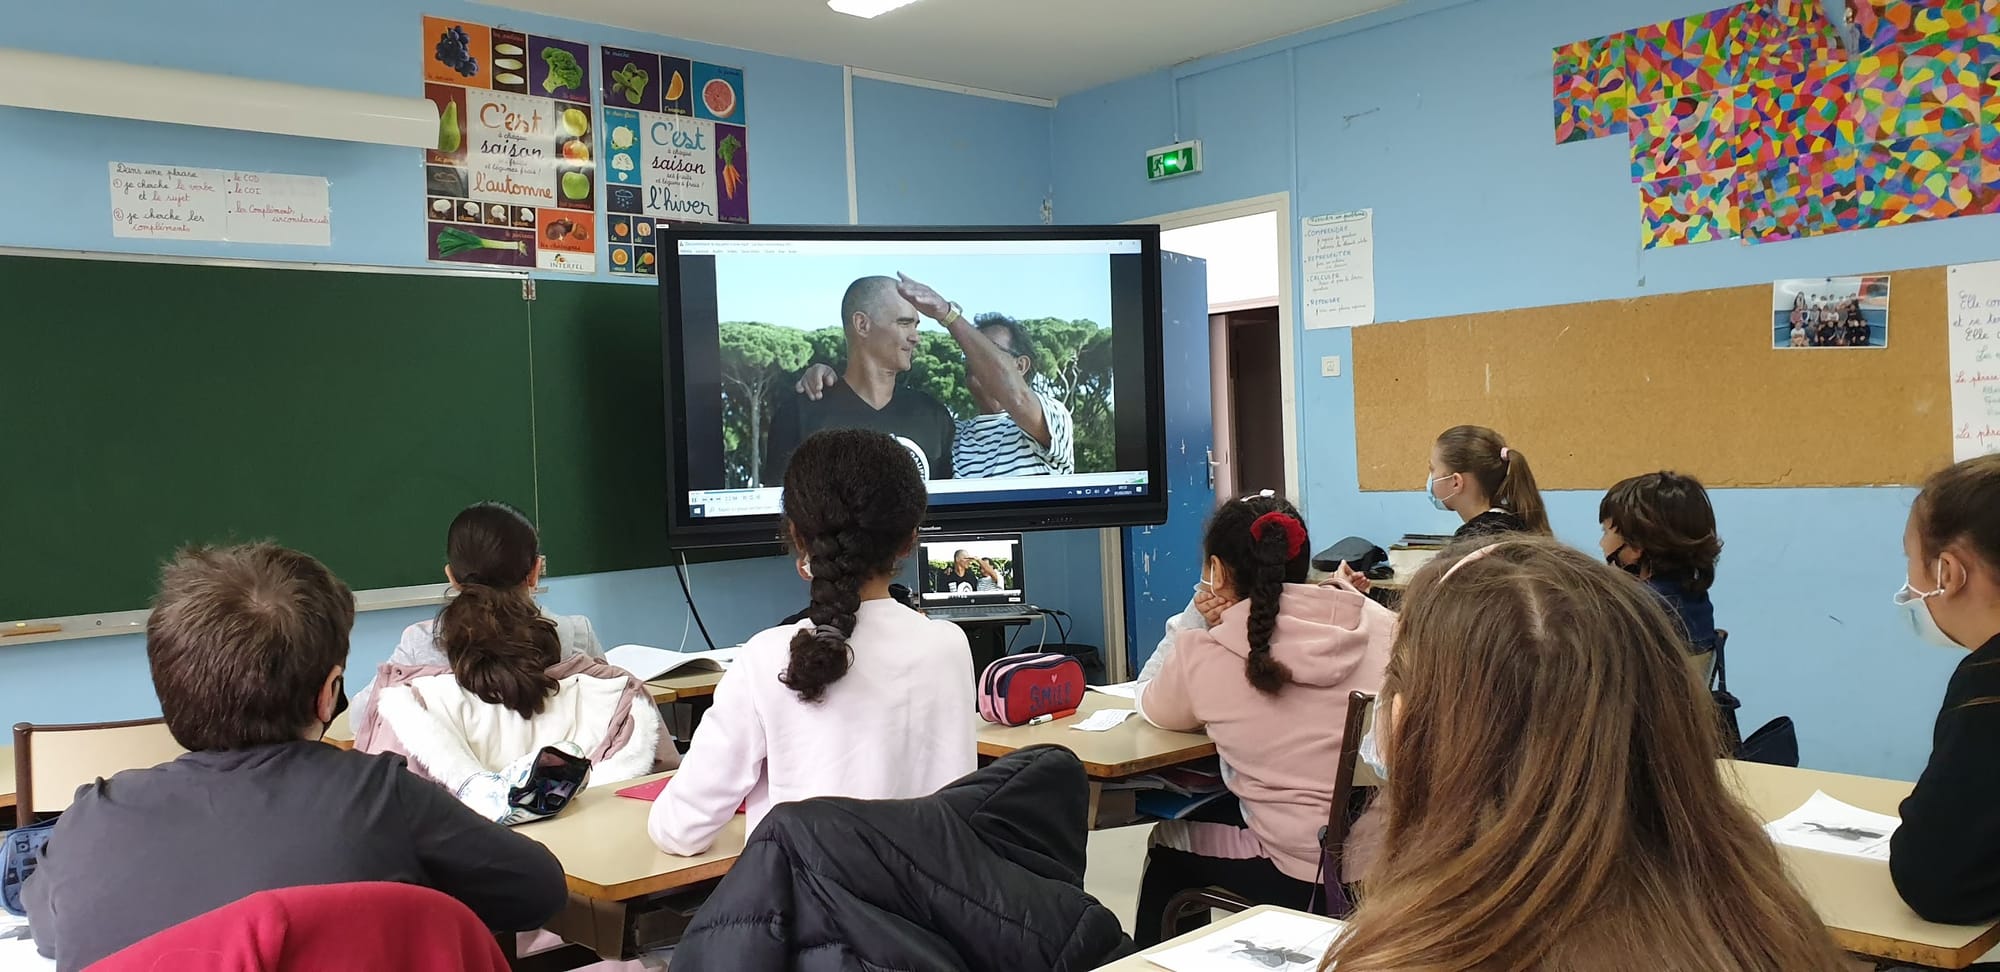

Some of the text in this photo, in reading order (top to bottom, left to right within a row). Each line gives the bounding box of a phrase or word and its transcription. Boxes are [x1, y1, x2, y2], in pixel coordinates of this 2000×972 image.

[480, 103, 542, 132] C'est
[651, 122, 706, 151] C'est
[116, 163, 142, 174] Dans
[167, 168, 198, 180] phrase
[651, 155, 706, 175] saison
[137, 179, 169, 190] cherche
[473, 170, 553, 199] l'automne
[167, 193, 191, 207] sujet
[647, 185, 713, 216] l'hiver
[143, 208, 182, 221] cherche
[187, 210, 205, 222] les
[1030, 681, 1072, 712] SMILE
